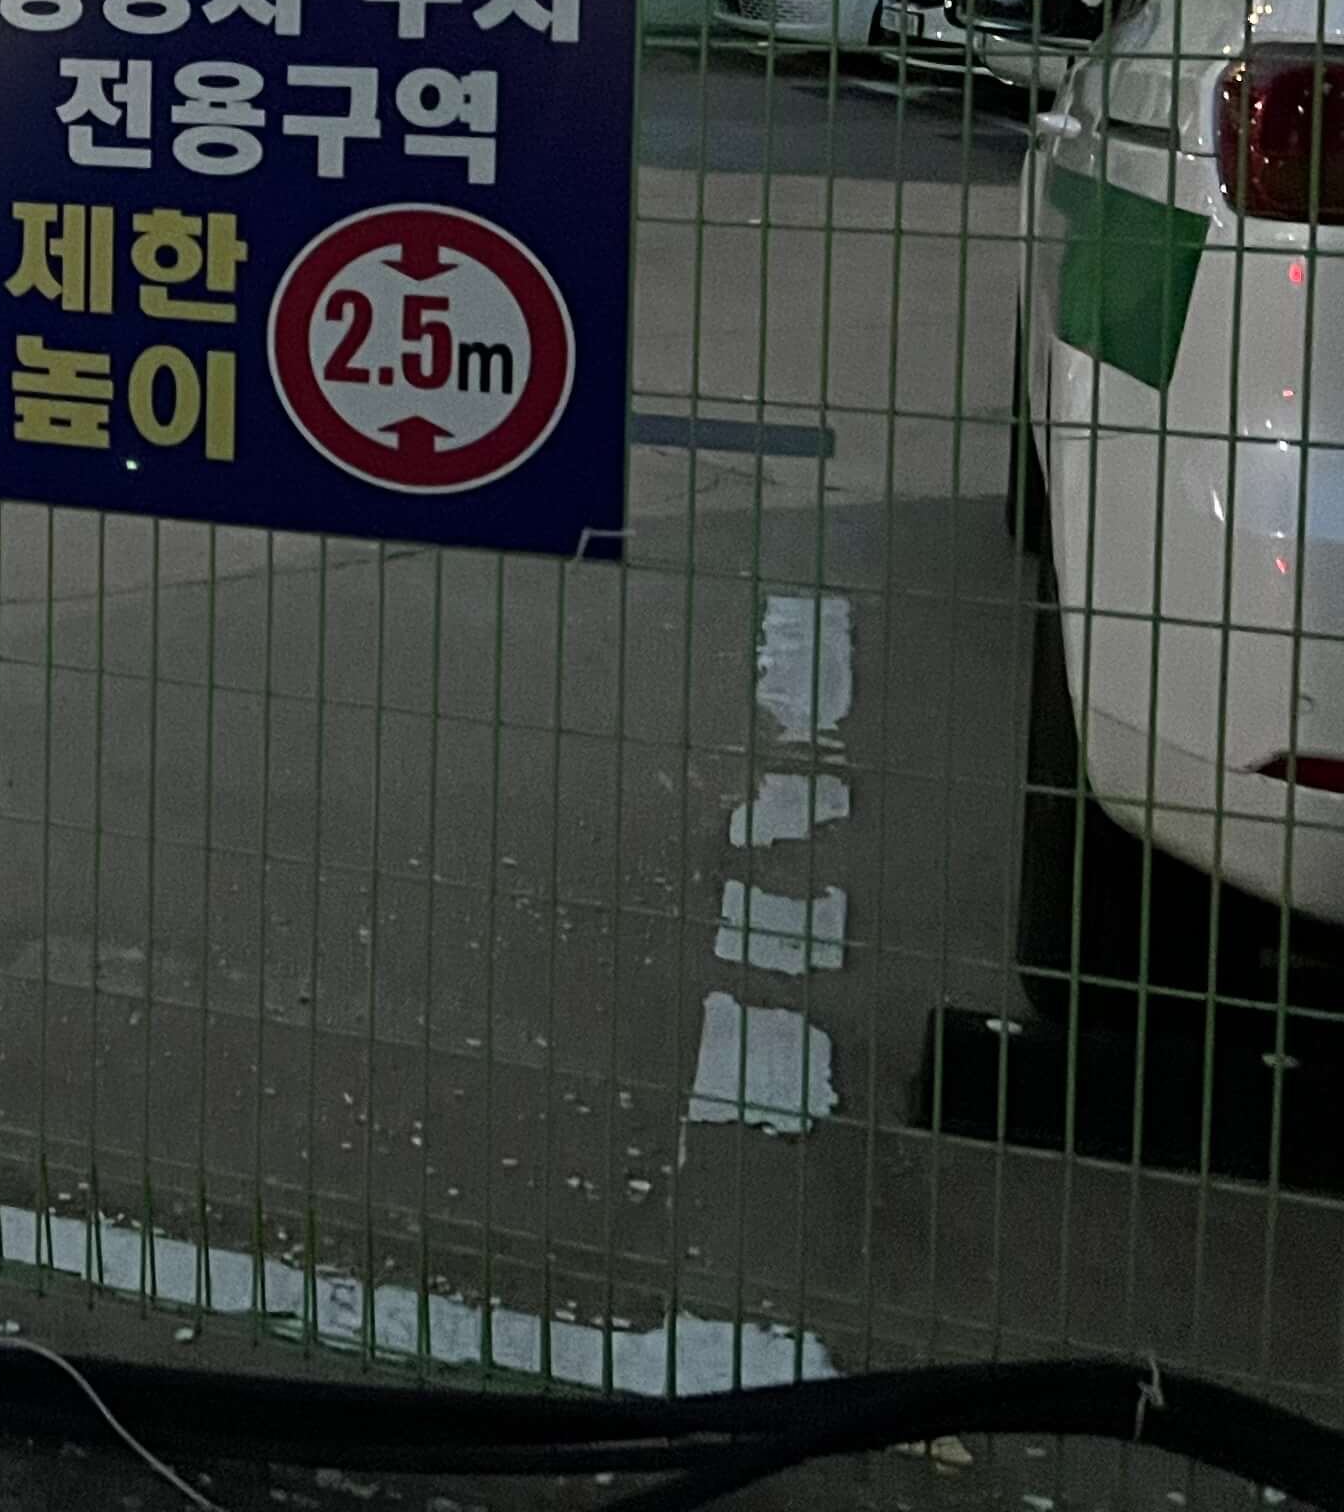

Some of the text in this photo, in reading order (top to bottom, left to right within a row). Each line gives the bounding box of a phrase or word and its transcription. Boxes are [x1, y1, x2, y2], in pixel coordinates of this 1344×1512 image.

[55, 58, 498, 185] 전용구역
[4, 202, 248, 324] 제한
[11, 334, 237, 462] 높이
[322, 288, 513, 395] 2.5m
